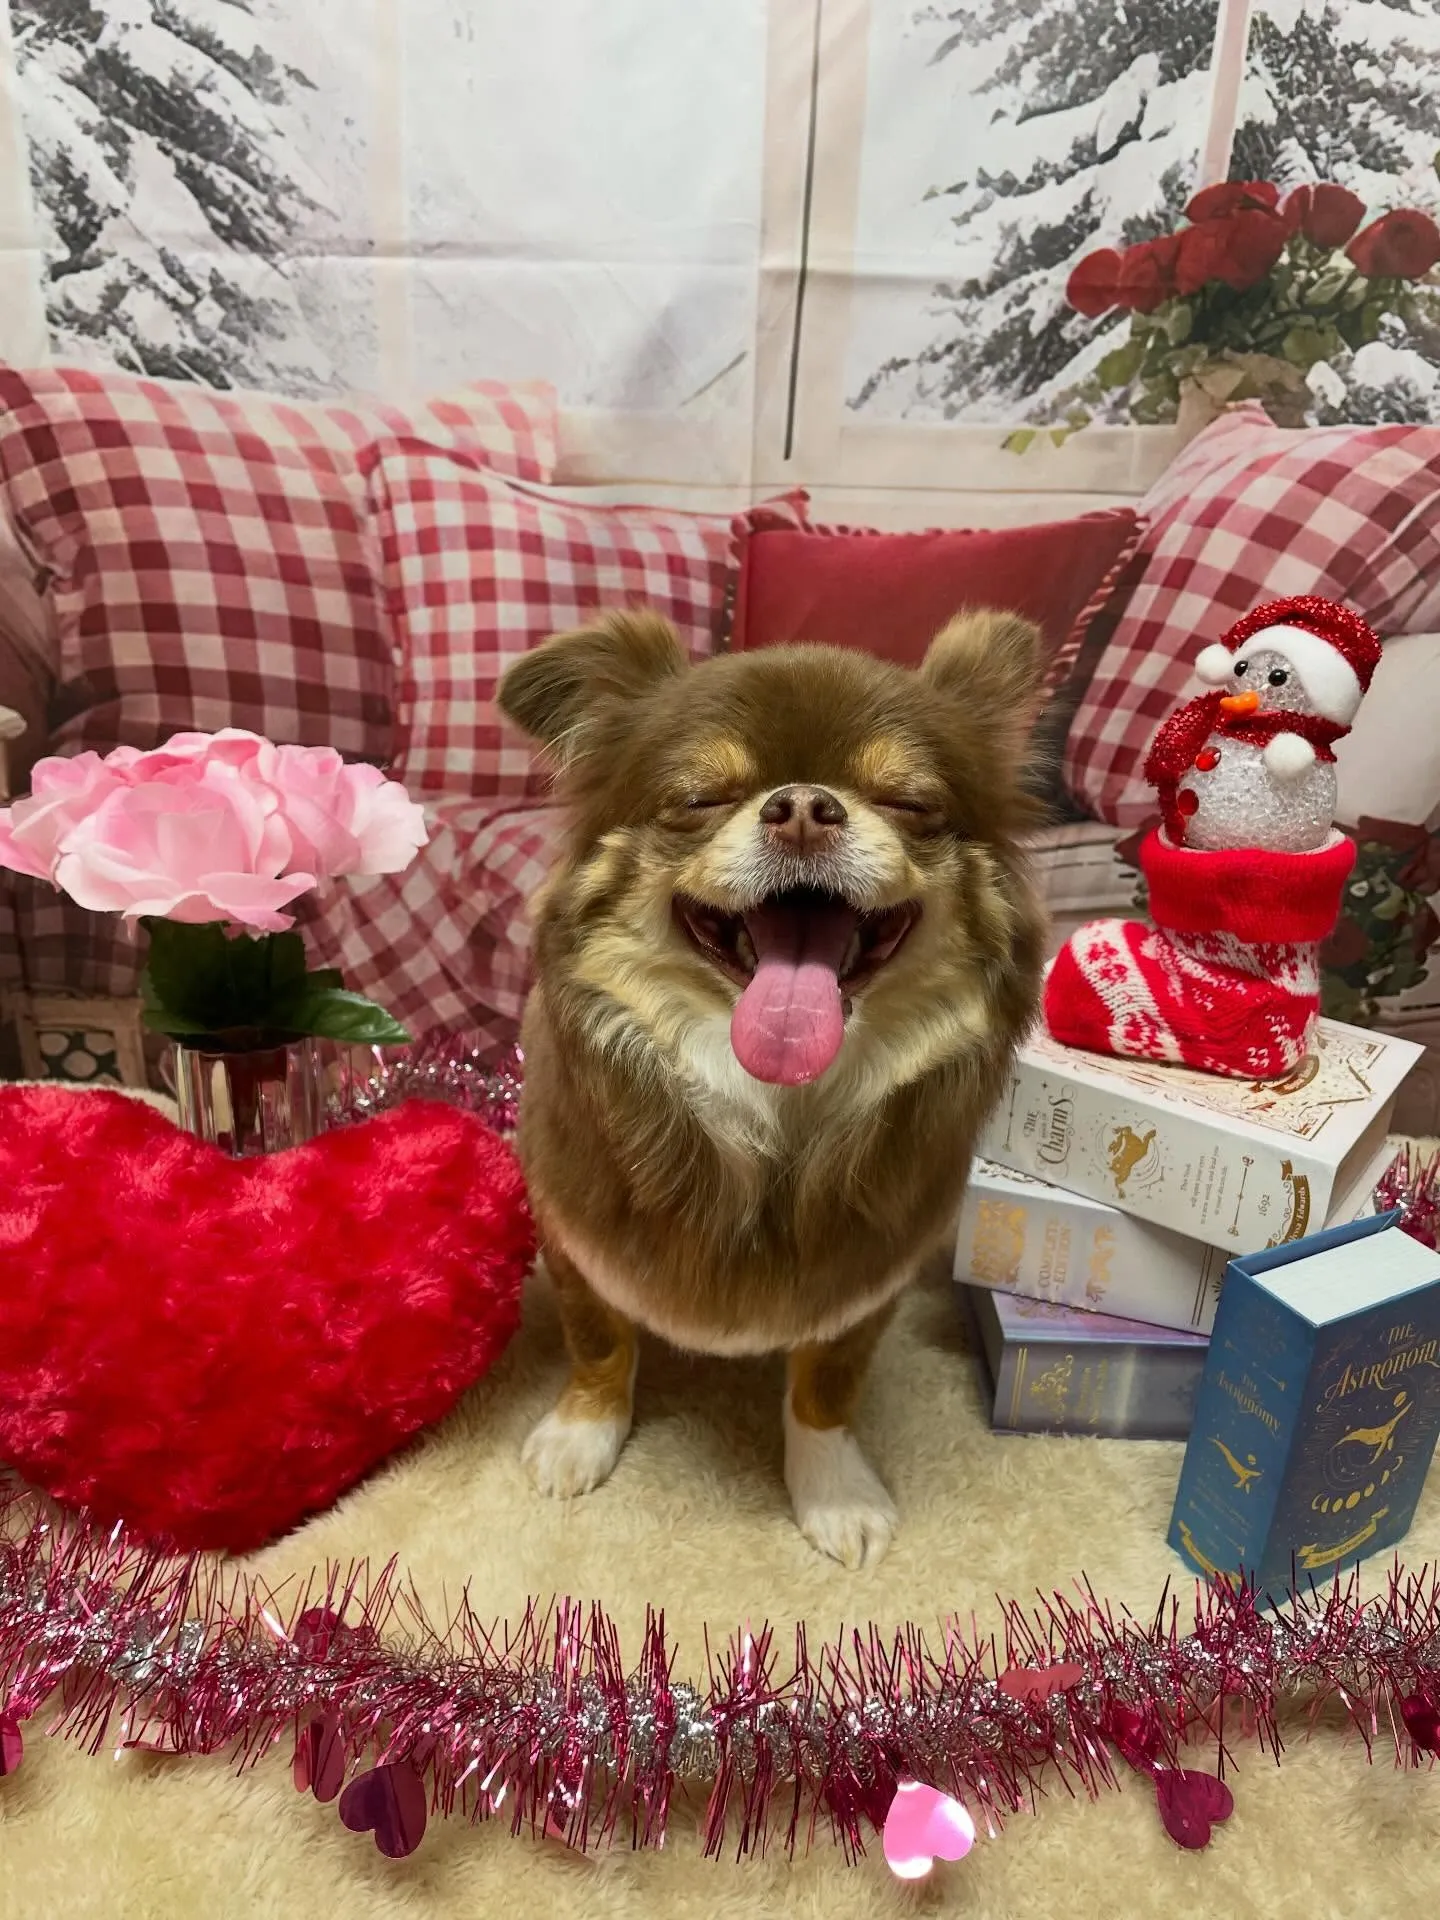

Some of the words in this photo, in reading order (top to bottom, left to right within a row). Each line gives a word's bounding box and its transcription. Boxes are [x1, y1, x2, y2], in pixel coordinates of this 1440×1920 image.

[1258, 1193, 1271, 1217] 1692
[1296, 1186, 1306, 1221] Edwards
[1386, 1322, 1416, 1345] THE
